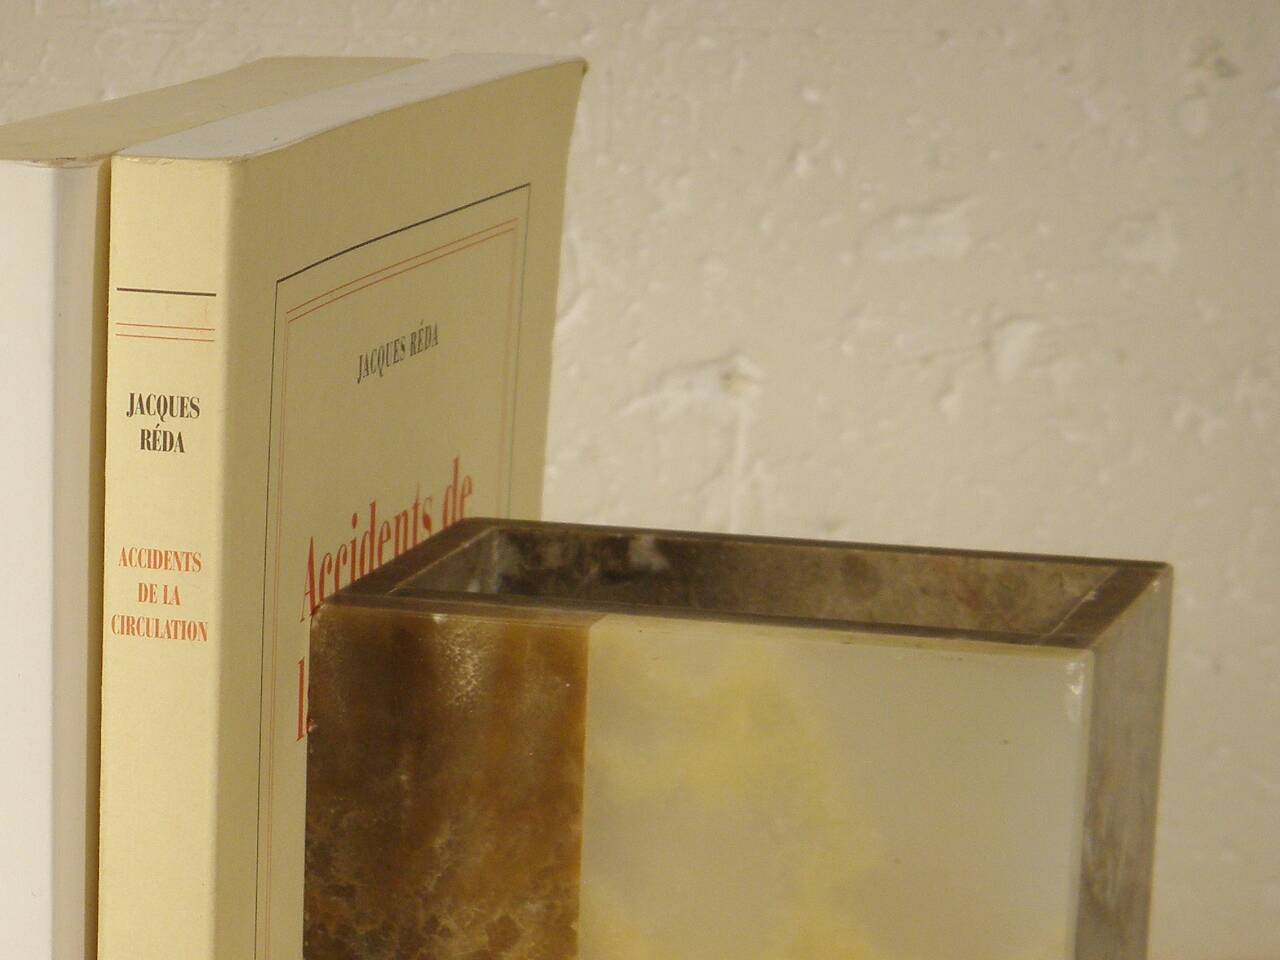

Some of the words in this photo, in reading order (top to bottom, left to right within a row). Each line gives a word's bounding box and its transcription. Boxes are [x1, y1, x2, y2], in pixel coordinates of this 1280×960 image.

[356, 335, 406, 385] JACQUES
[409, 320, 439, 361] RÉDA
[126, 392, 200, 423] JACQUES
[140, 423, 185, 454] RÉDA
[118, 546, 203, 573] ACCIDENTS
[137, 582, 158, 604] DE
[163, 584, 181, 606] LA
[111, 614, 208, 642] CIRCULATION
